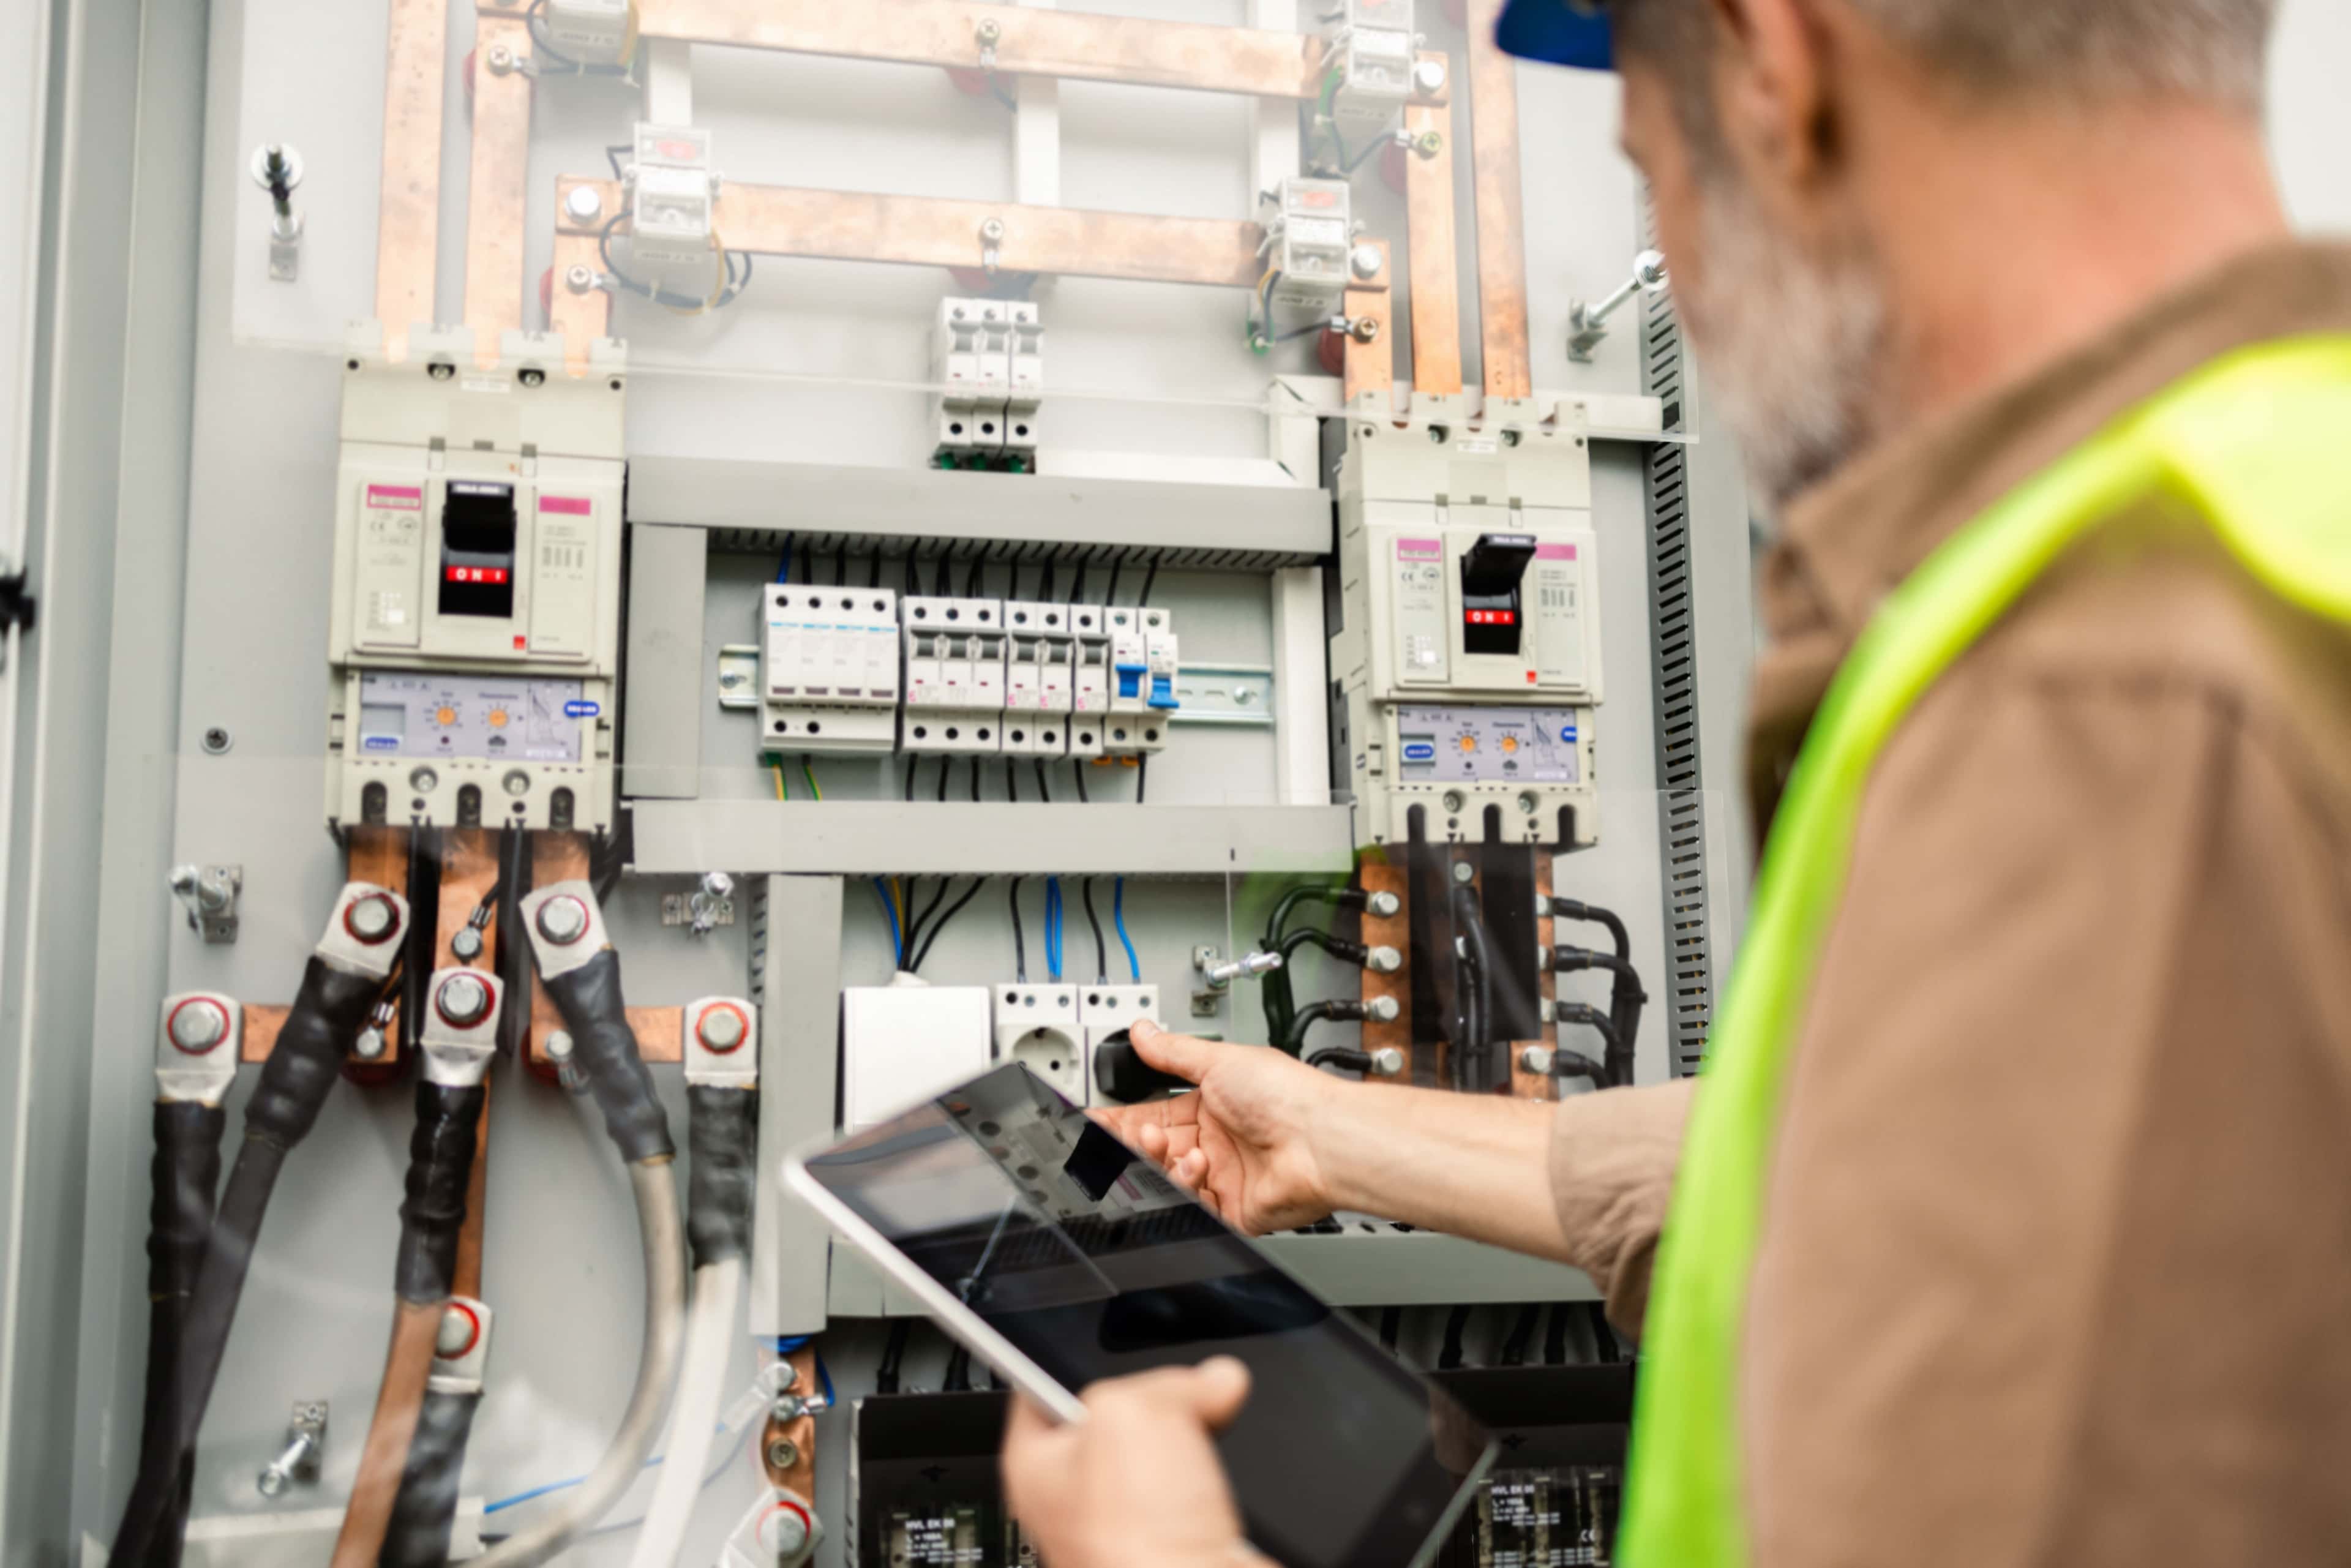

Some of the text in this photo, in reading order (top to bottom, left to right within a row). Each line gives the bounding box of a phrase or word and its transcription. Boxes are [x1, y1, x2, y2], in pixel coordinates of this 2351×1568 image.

[456, 568, 482, 582] ON
[1472, 611, 1494, 623] ON
[927, 1518, 942, 1529] EK
